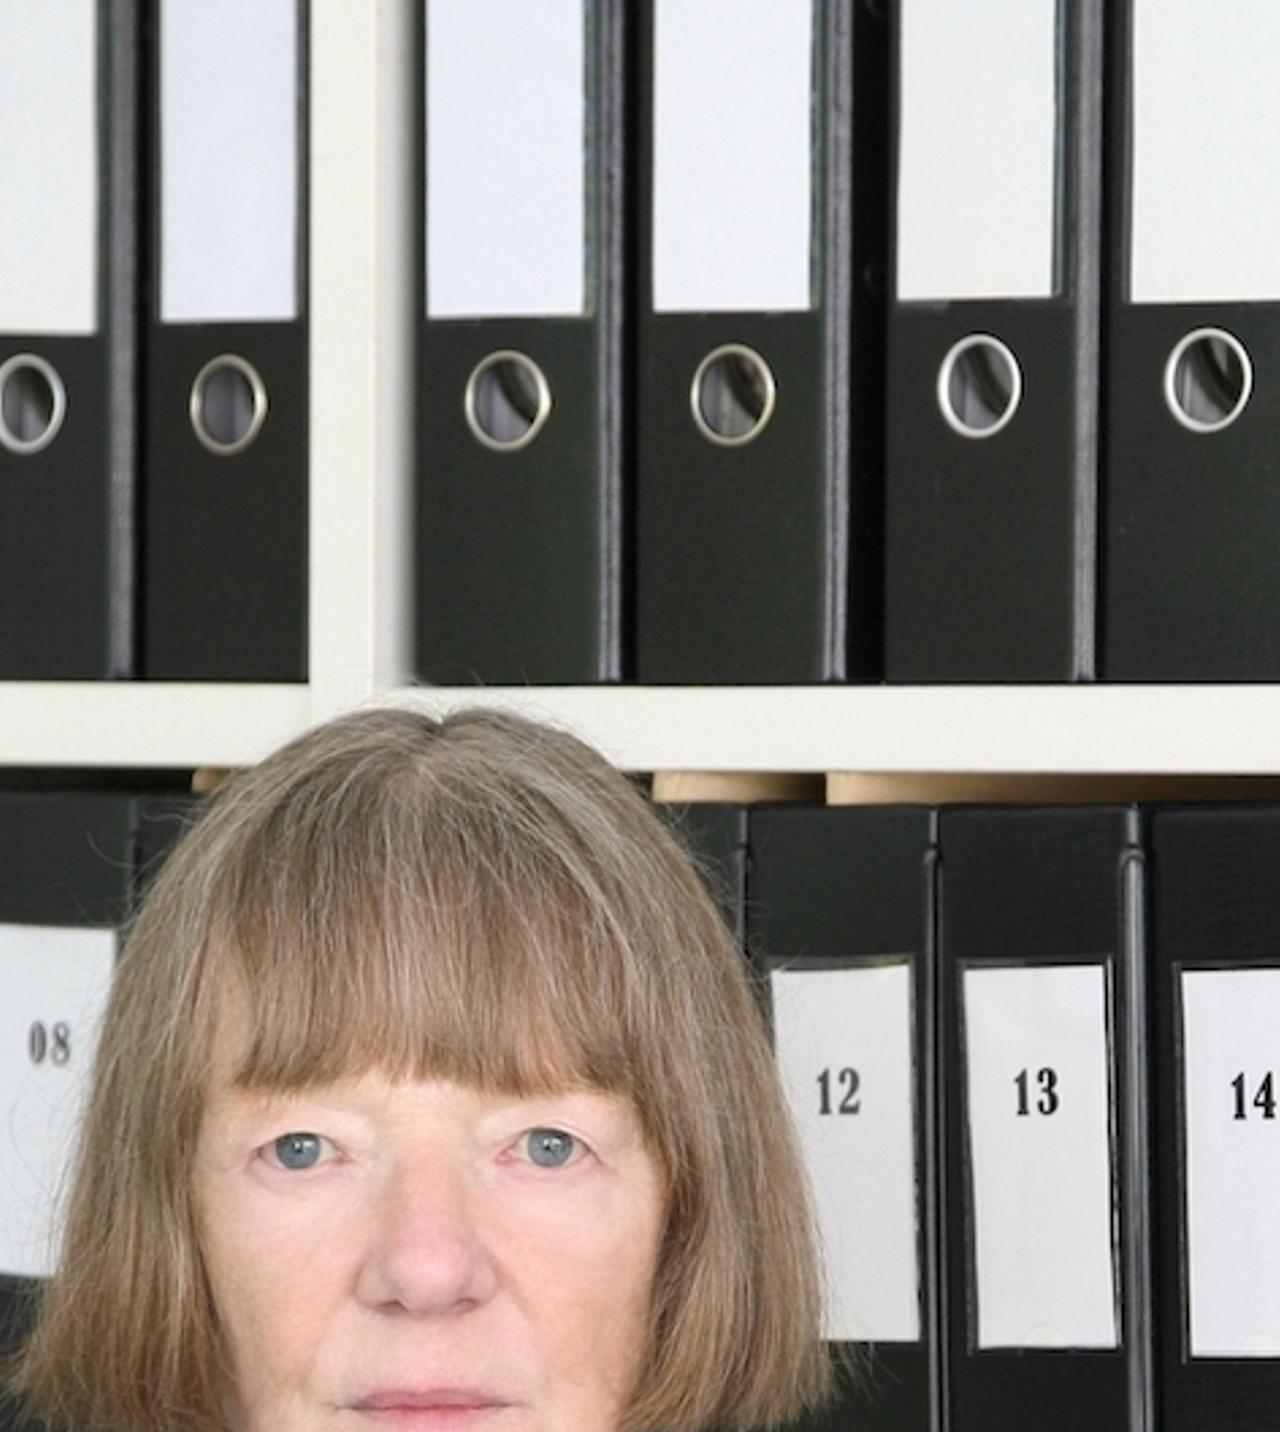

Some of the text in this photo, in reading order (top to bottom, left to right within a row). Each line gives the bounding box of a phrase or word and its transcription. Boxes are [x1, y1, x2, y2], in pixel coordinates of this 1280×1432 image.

[28, 1020, 72, 1067] 08
[816, 1067, 861, 1116] 12
[1013, 1067, 1059, 1117] 13
[1231, 1071, 1277, 1121] 14
